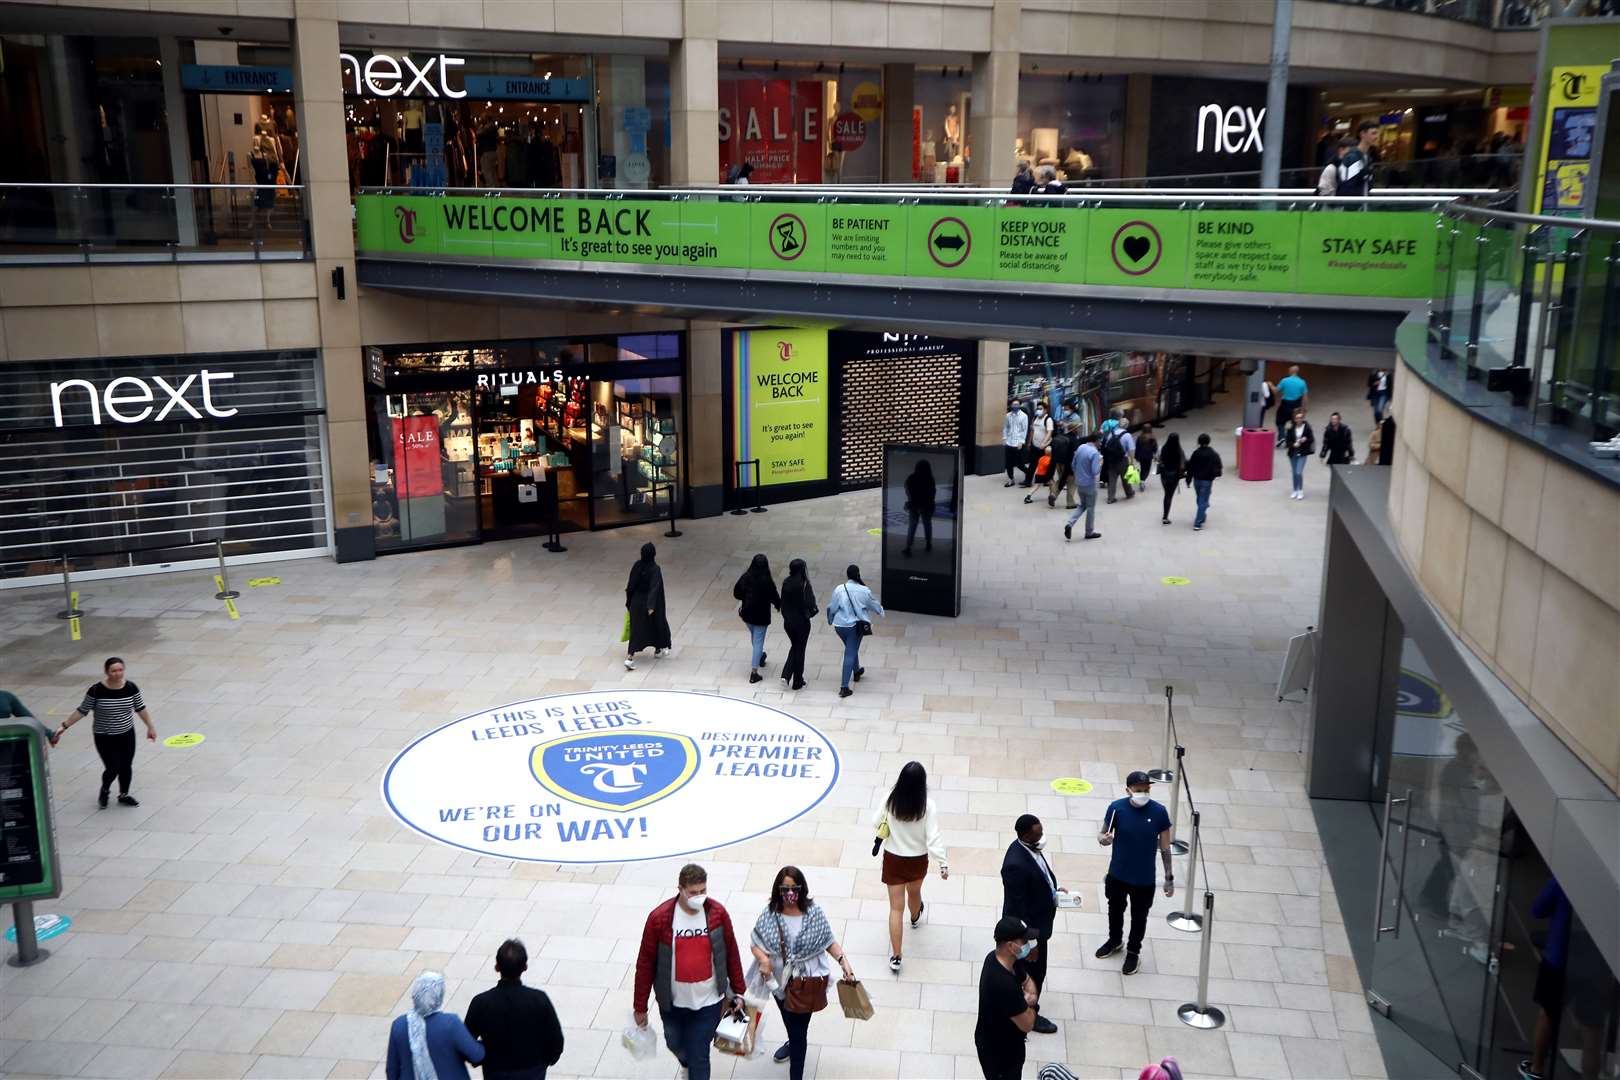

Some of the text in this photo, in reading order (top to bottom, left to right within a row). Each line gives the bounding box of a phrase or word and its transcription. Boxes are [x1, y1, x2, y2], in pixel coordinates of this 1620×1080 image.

[224, 70, 279, 86] ENTRANCE
[506, 79, 551, 95] ENTRANCE
[718, 107, 818, 141] SALE
[836, 120, 865, 135] SALE
[1197, 103, 1267, 153] nex
[443, 204, 652, 236] WELCOME BACK
[832, 218, 890, 231] BE PATIENT
[1001, 220, 1067, 234] KEEP YOUR
[1198, 222, 1254, 235] BE KIND
[832, 233, 843, 241] We
[855, 234, 880, 244] limiting
[1000, 234, 1060, 247] DISTANCE
[1196, 239, 1272, 251] Please give others
[561, 237, 718, 262] It's great to see you again
[832, 244, 859, 252] numbers
[873, 245, 886, 253] you
[1322, 238, 1367, 254] STAY
[1371, 239, 1417, 256] SAFE
[832, 253, 846, 262] may
[1000, 250, 1023, 260] Please
[1024, 251, 1034, 260] be
[1059, 251, 1068, 261] of
[1195, 251, 1288, 262] space and respect our
[1000, 260, 1020, 269] social
[1194, 260, 1214, 269] staff
[1216, 262, 1225, 270] as
[1241, 263, 1255, 272] try
[1256, 263, 1266, 271] to
[1268, 263, 1290, 273] keep
[1194, 272, 1237, 283] everybody
[918, 344, 945, 352] MAKEUP
[757, 371, 818, 387] WELCOME
[51, 369, 239, 428] next
[772, 385, 804, 399] BACK
[762, 424, 773, 433] It's
[774, 423, 792, 433] great
[399, 431, 434, 444] SALE
[770, 431, 806, 443] you again!
[771, 458, 805, 469] STAY SAFE
[491, 700, 633, 724] THIS IS LEEDS
[471, 712, 652, 741] LEEDS LEEDS.
[564, 742, 664, 754] TRINITY LEEDS
[709, 744, 823, 760] PREMIER
[564, 748, 665, 763] UNITED
[714, 762, 821, 779] LEAGUE.
[439, 803, 561, 823] WE'RE ON
[482, 816, 648, 843] OUR WAY!
